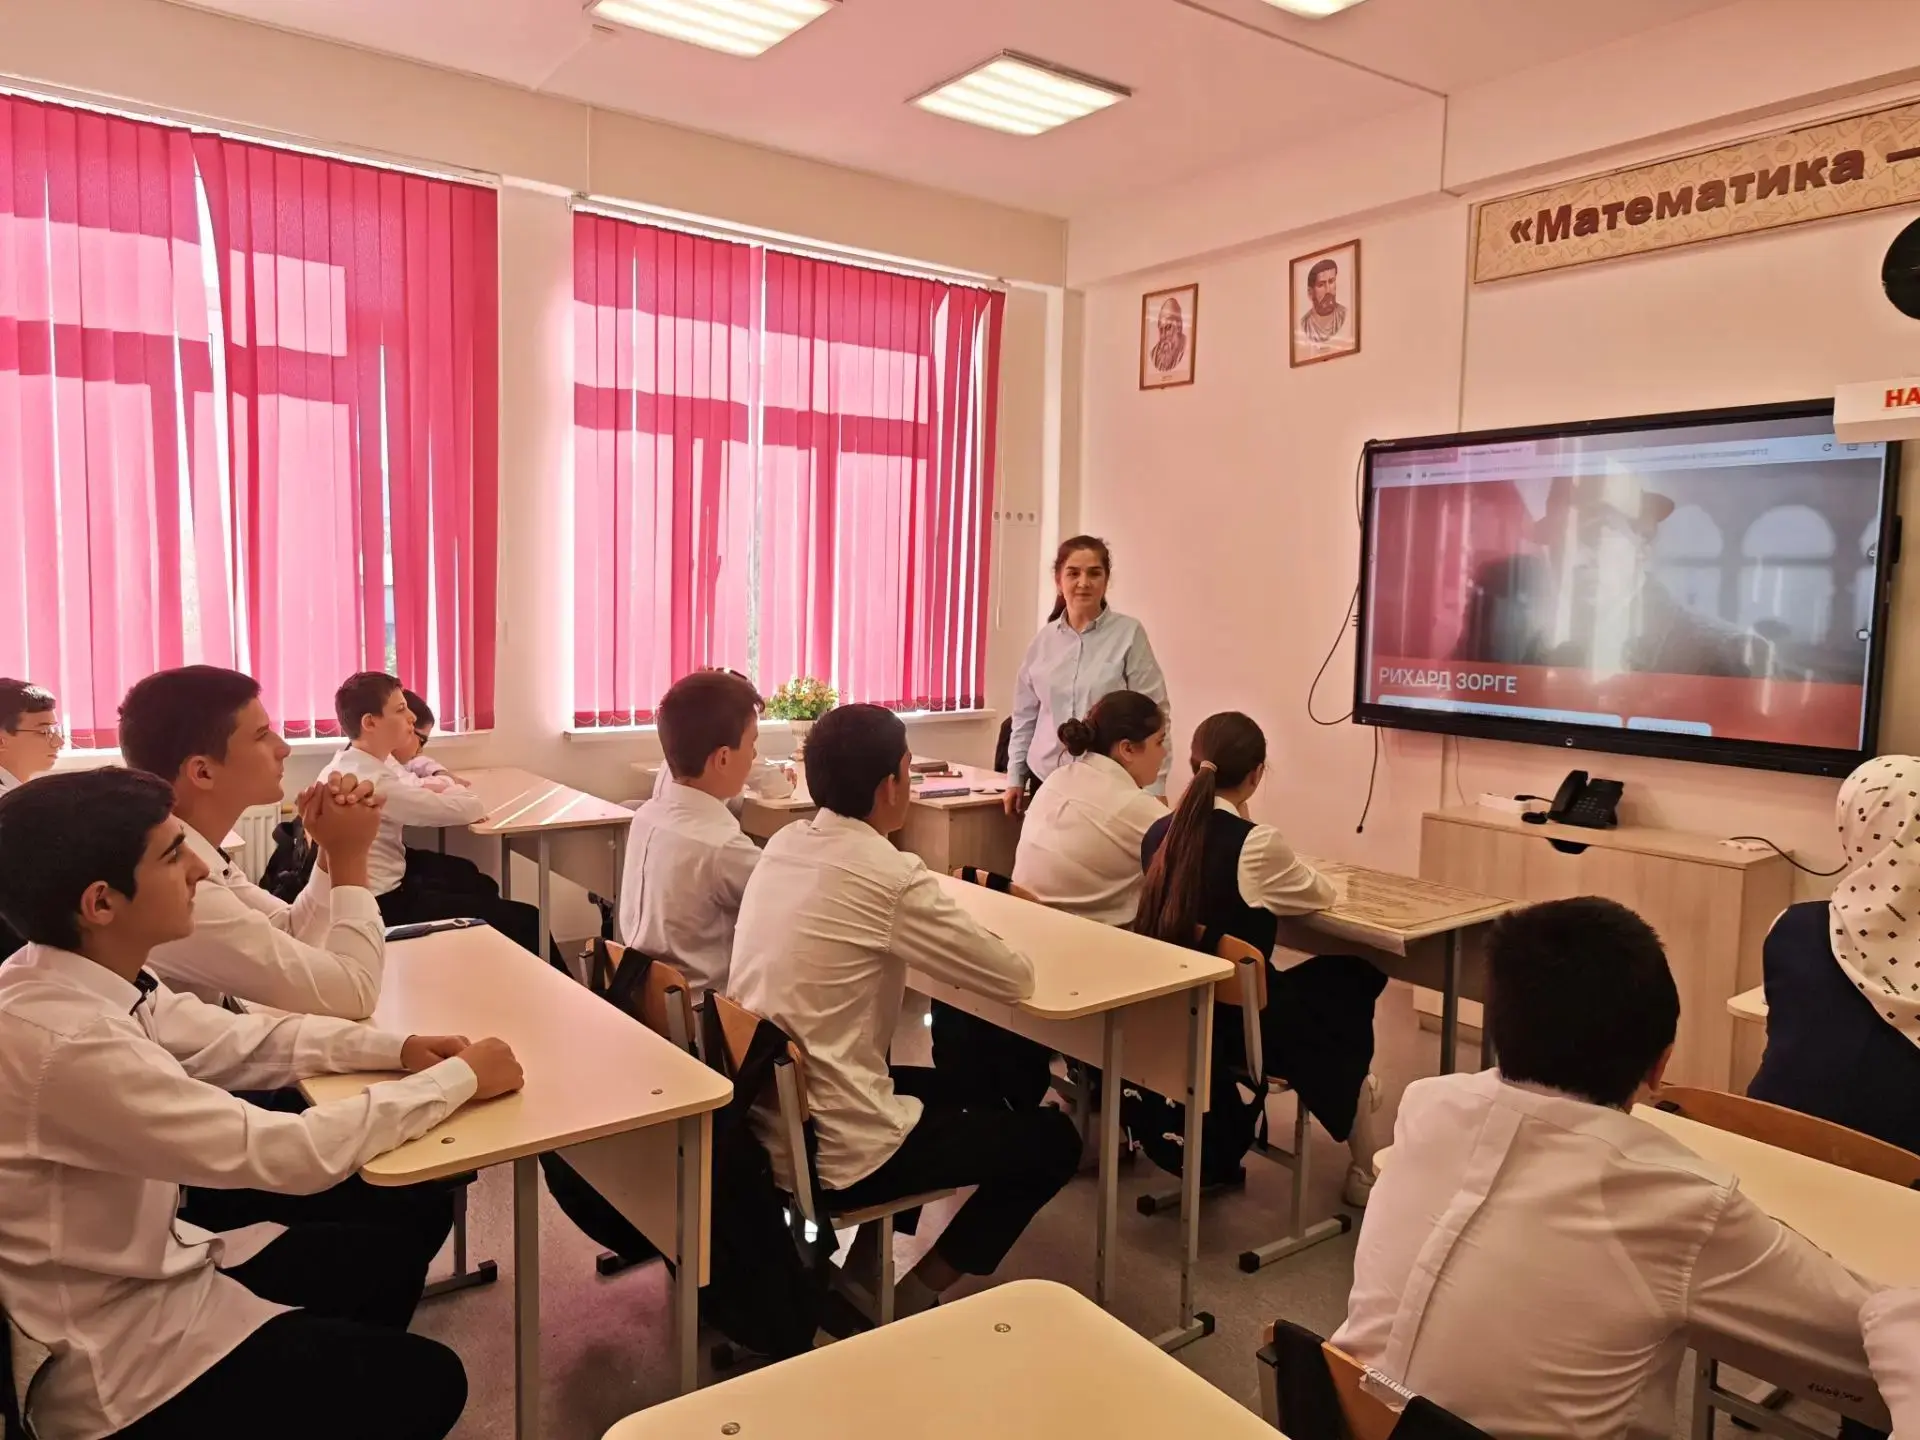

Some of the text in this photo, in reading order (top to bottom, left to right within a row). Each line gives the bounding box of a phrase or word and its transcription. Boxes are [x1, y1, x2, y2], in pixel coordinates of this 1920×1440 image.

[1509, 149, 1865, 245] «Математика
[1379, 667, 1518, 694] РИХАРД ЗОРГЕ
